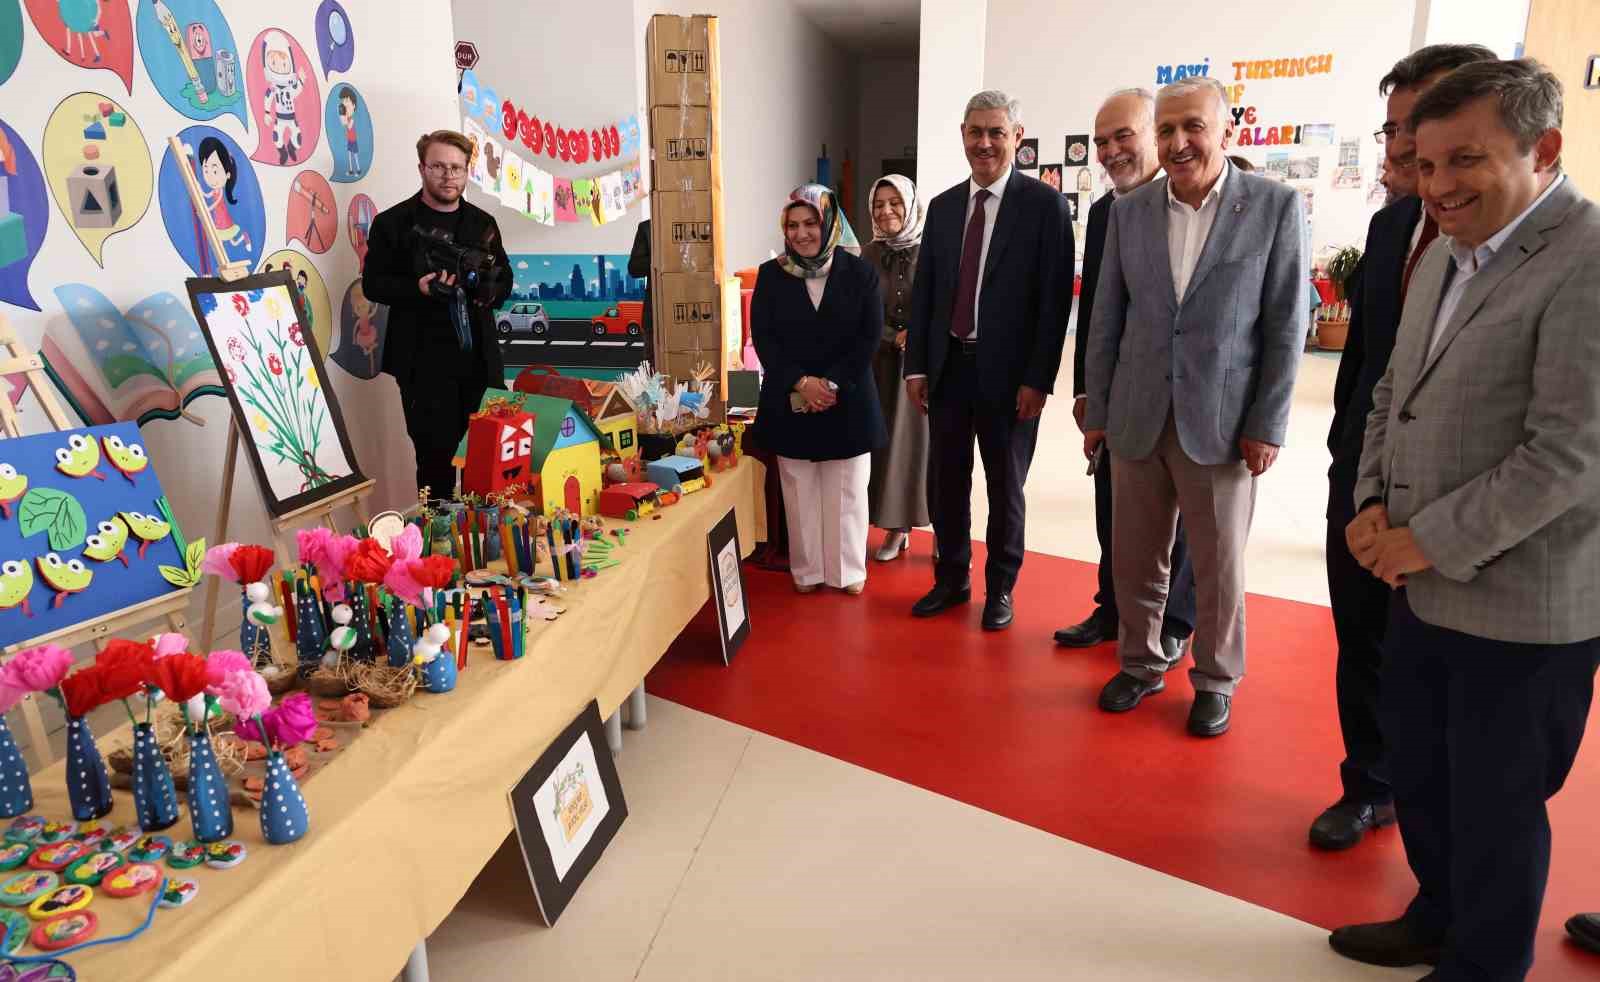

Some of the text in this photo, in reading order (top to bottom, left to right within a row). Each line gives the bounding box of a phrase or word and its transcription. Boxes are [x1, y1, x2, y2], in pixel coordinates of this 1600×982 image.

[1231, 54, 1333, 80] TURUNCU
[1231, 106, 1257, 126] YE
[1237, 125, 1302, 146] ALARI
